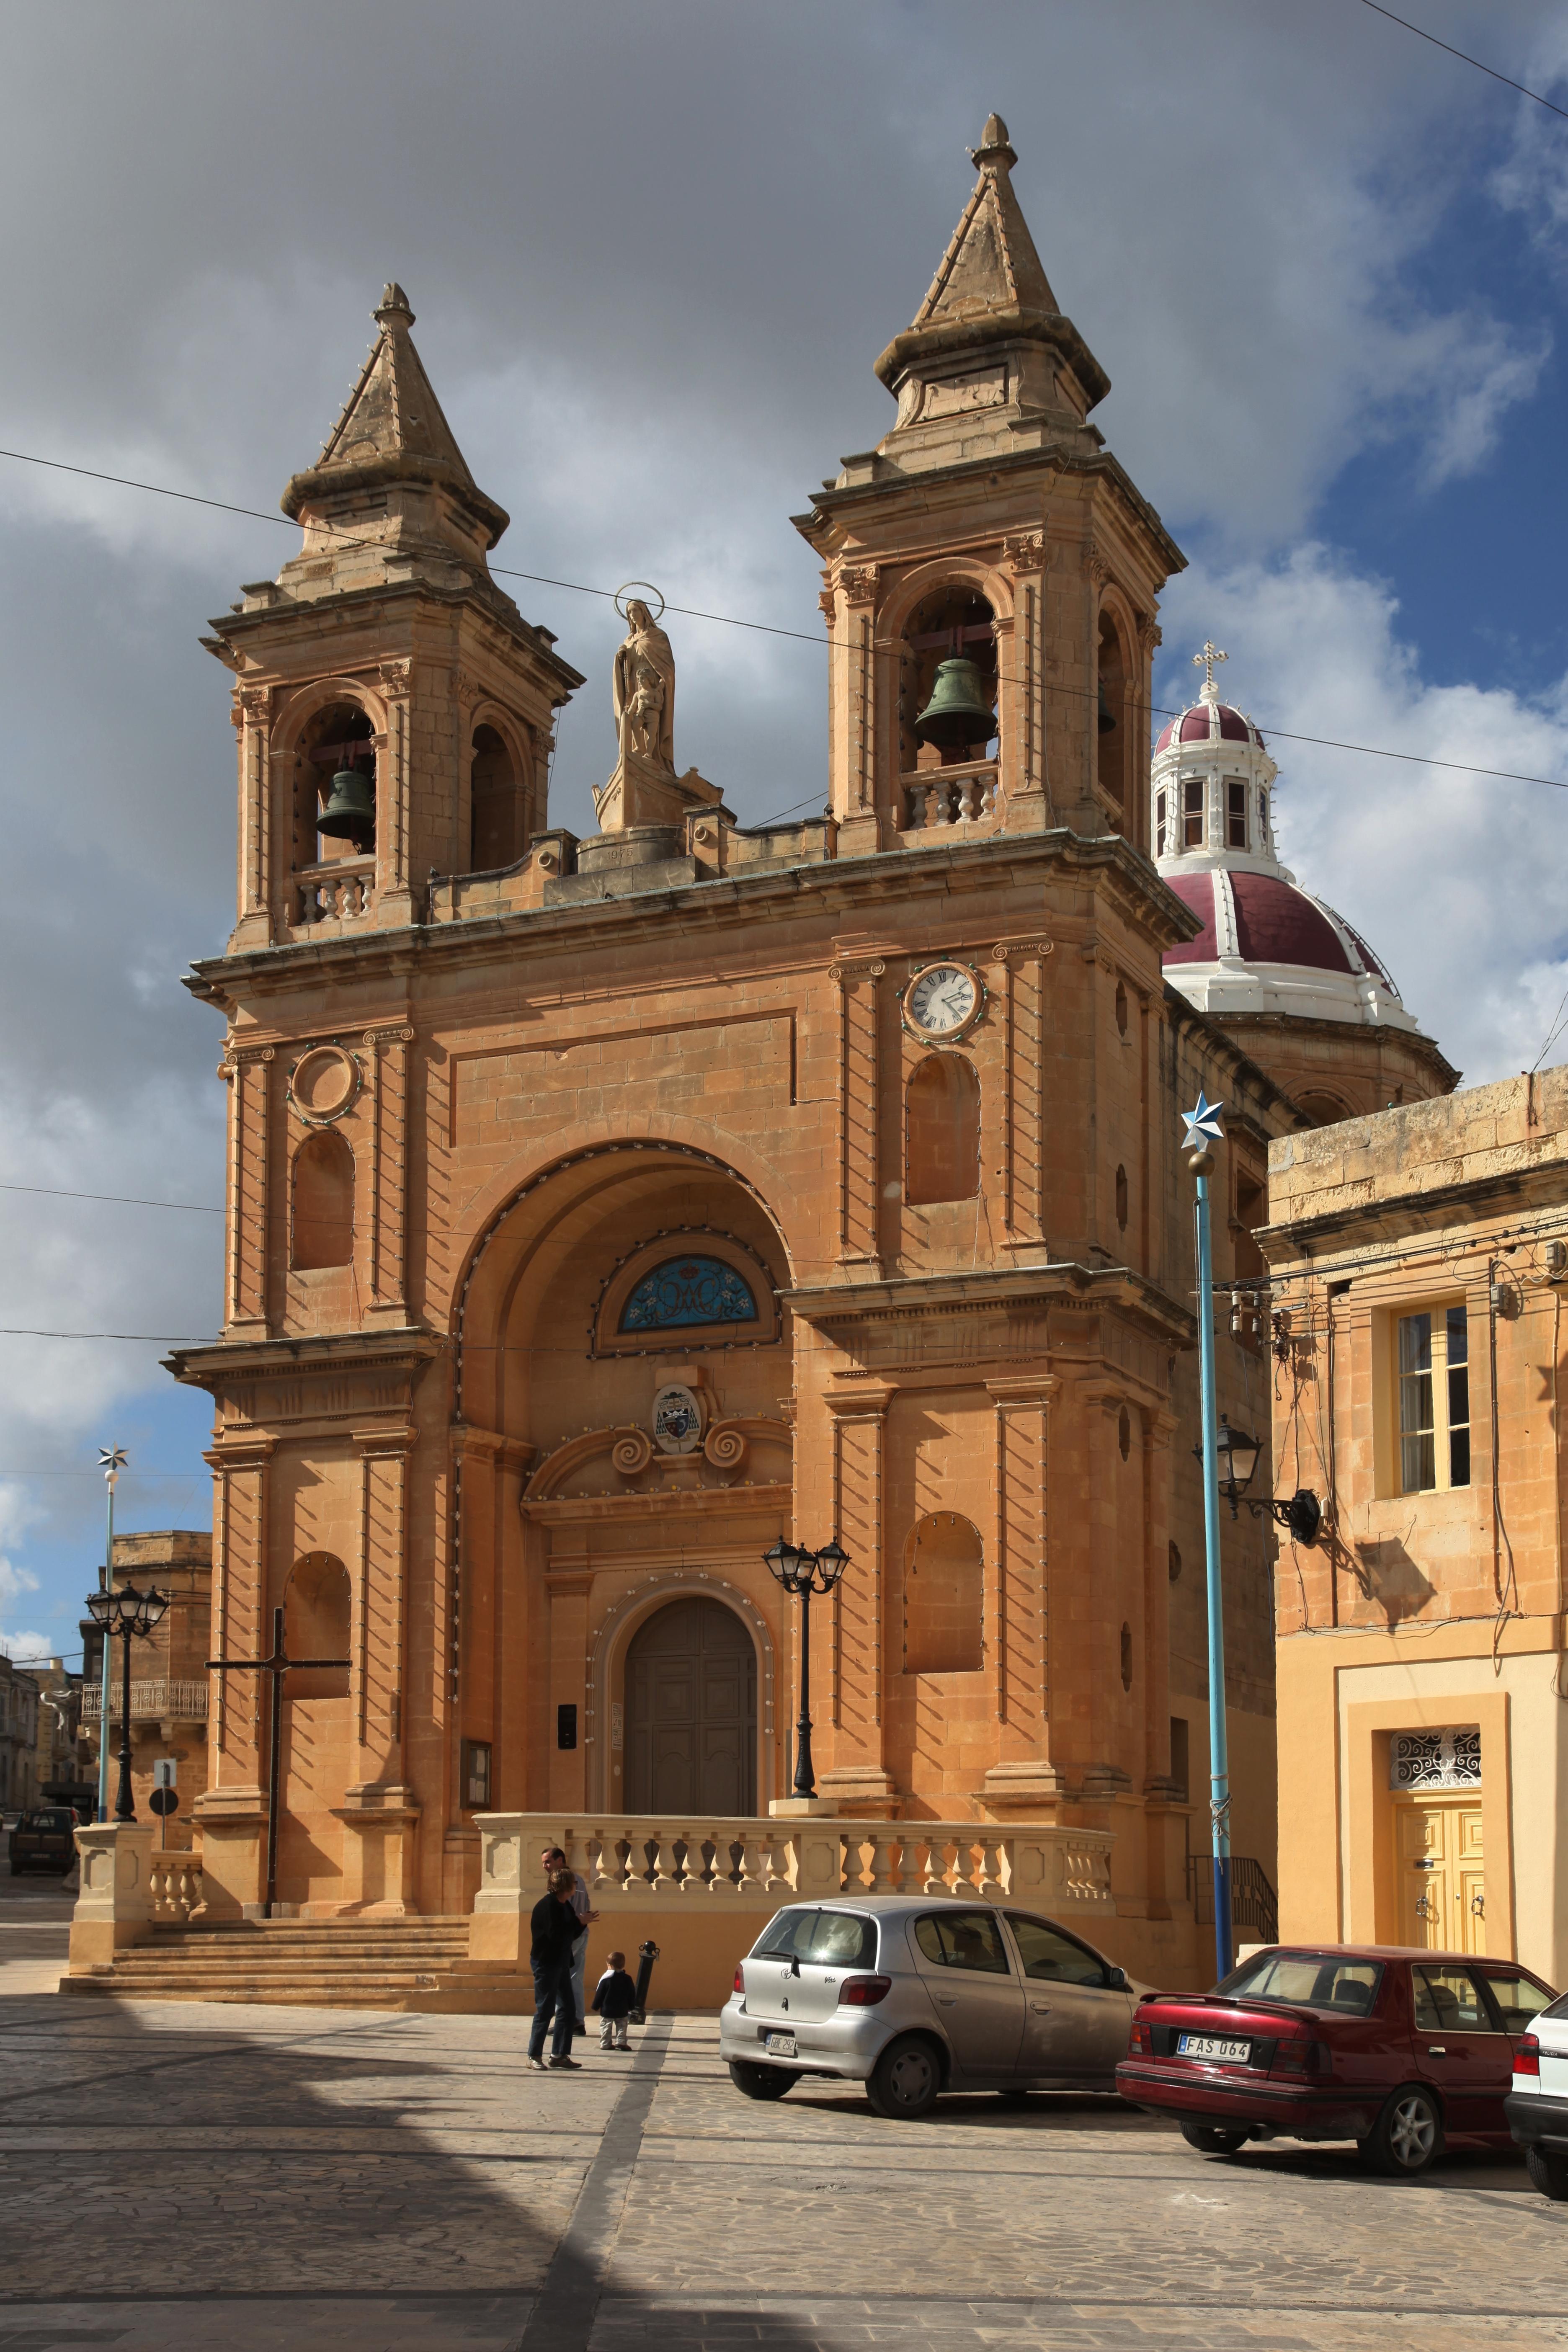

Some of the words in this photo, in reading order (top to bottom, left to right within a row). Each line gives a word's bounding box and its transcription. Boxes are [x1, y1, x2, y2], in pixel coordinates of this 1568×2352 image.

[607, 848, 633, 860] 1975
[926, 976, 936, 986] XI
[771, 2037, 782, 2049] GBE
[782, 2038, 794, 2050] 292
[1186, 2038, 1214, 2053] FAS
[1220, 2041, 1247, 2057] 064
